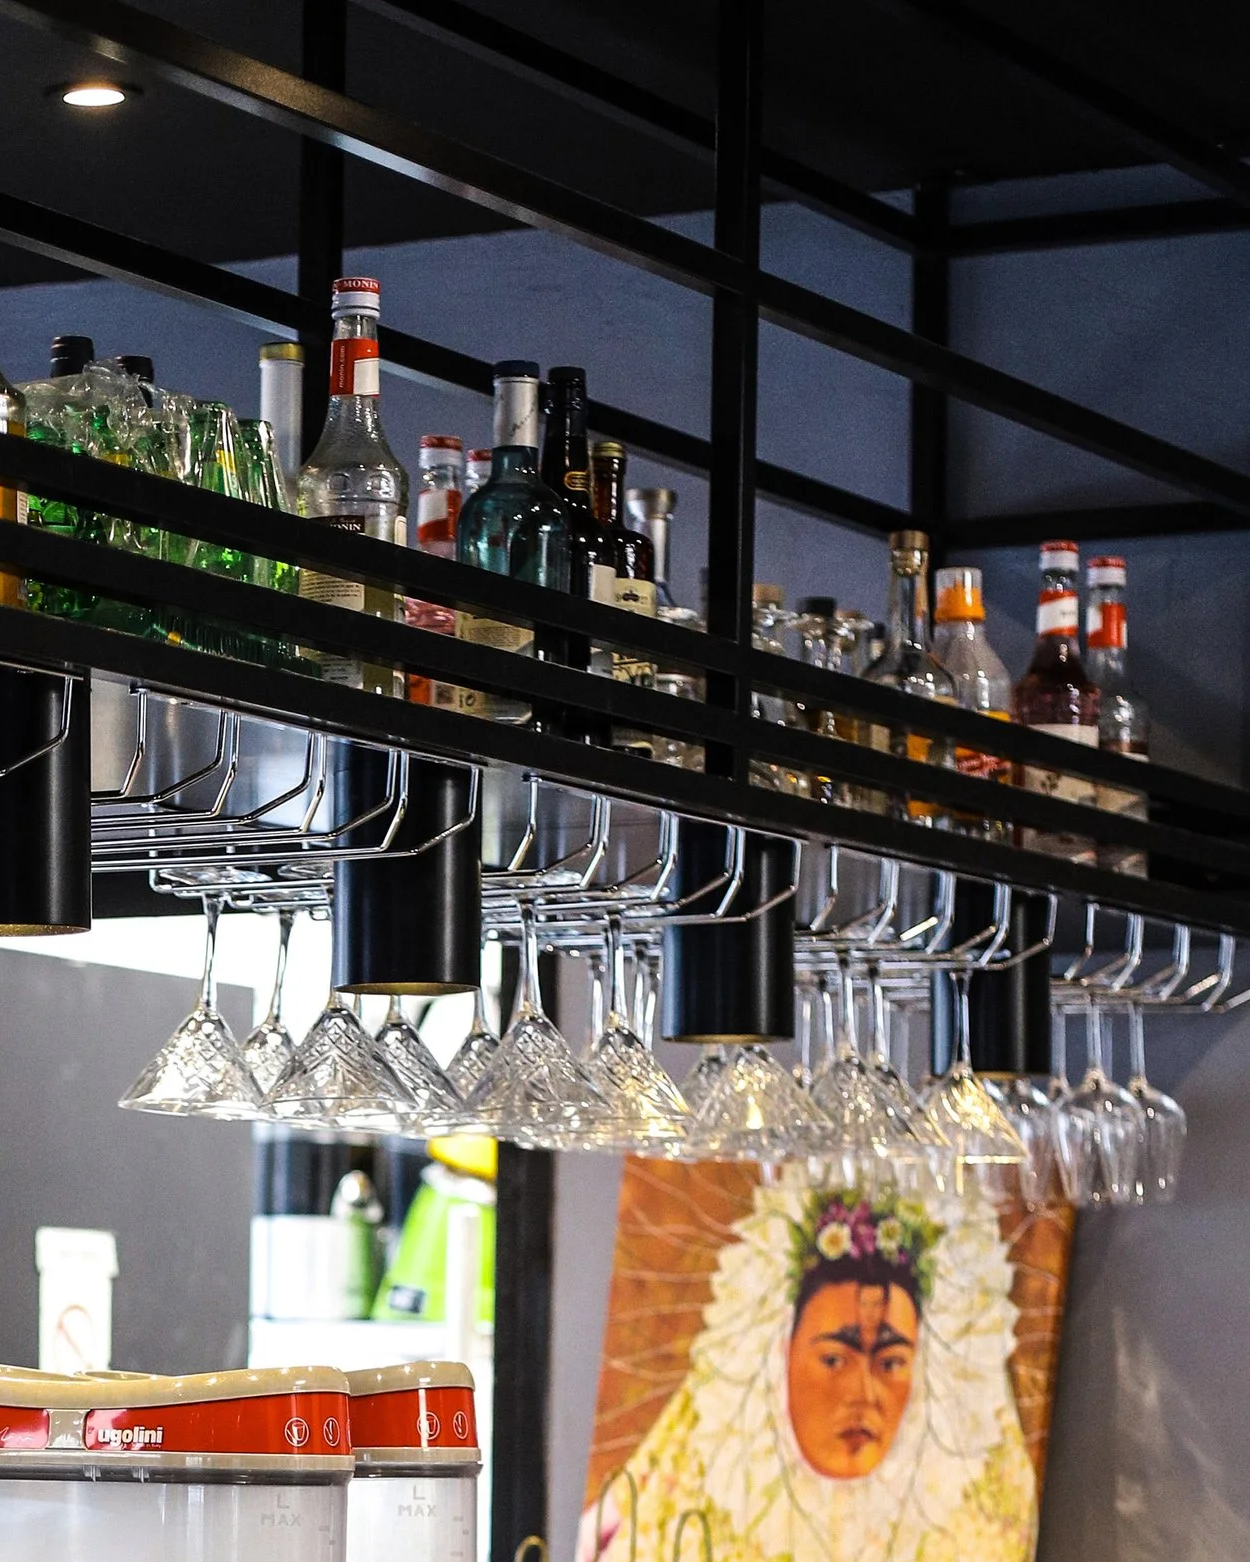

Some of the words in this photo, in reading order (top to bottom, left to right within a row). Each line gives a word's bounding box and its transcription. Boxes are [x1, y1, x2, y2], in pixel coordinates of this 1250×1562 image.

[343, 280, 379, 289] MONIN
[97, 1426, 163, 1447] ugolini
[398, 1504, 437, 1517] MAX
[260, 1513, 301, 1527] MAX
